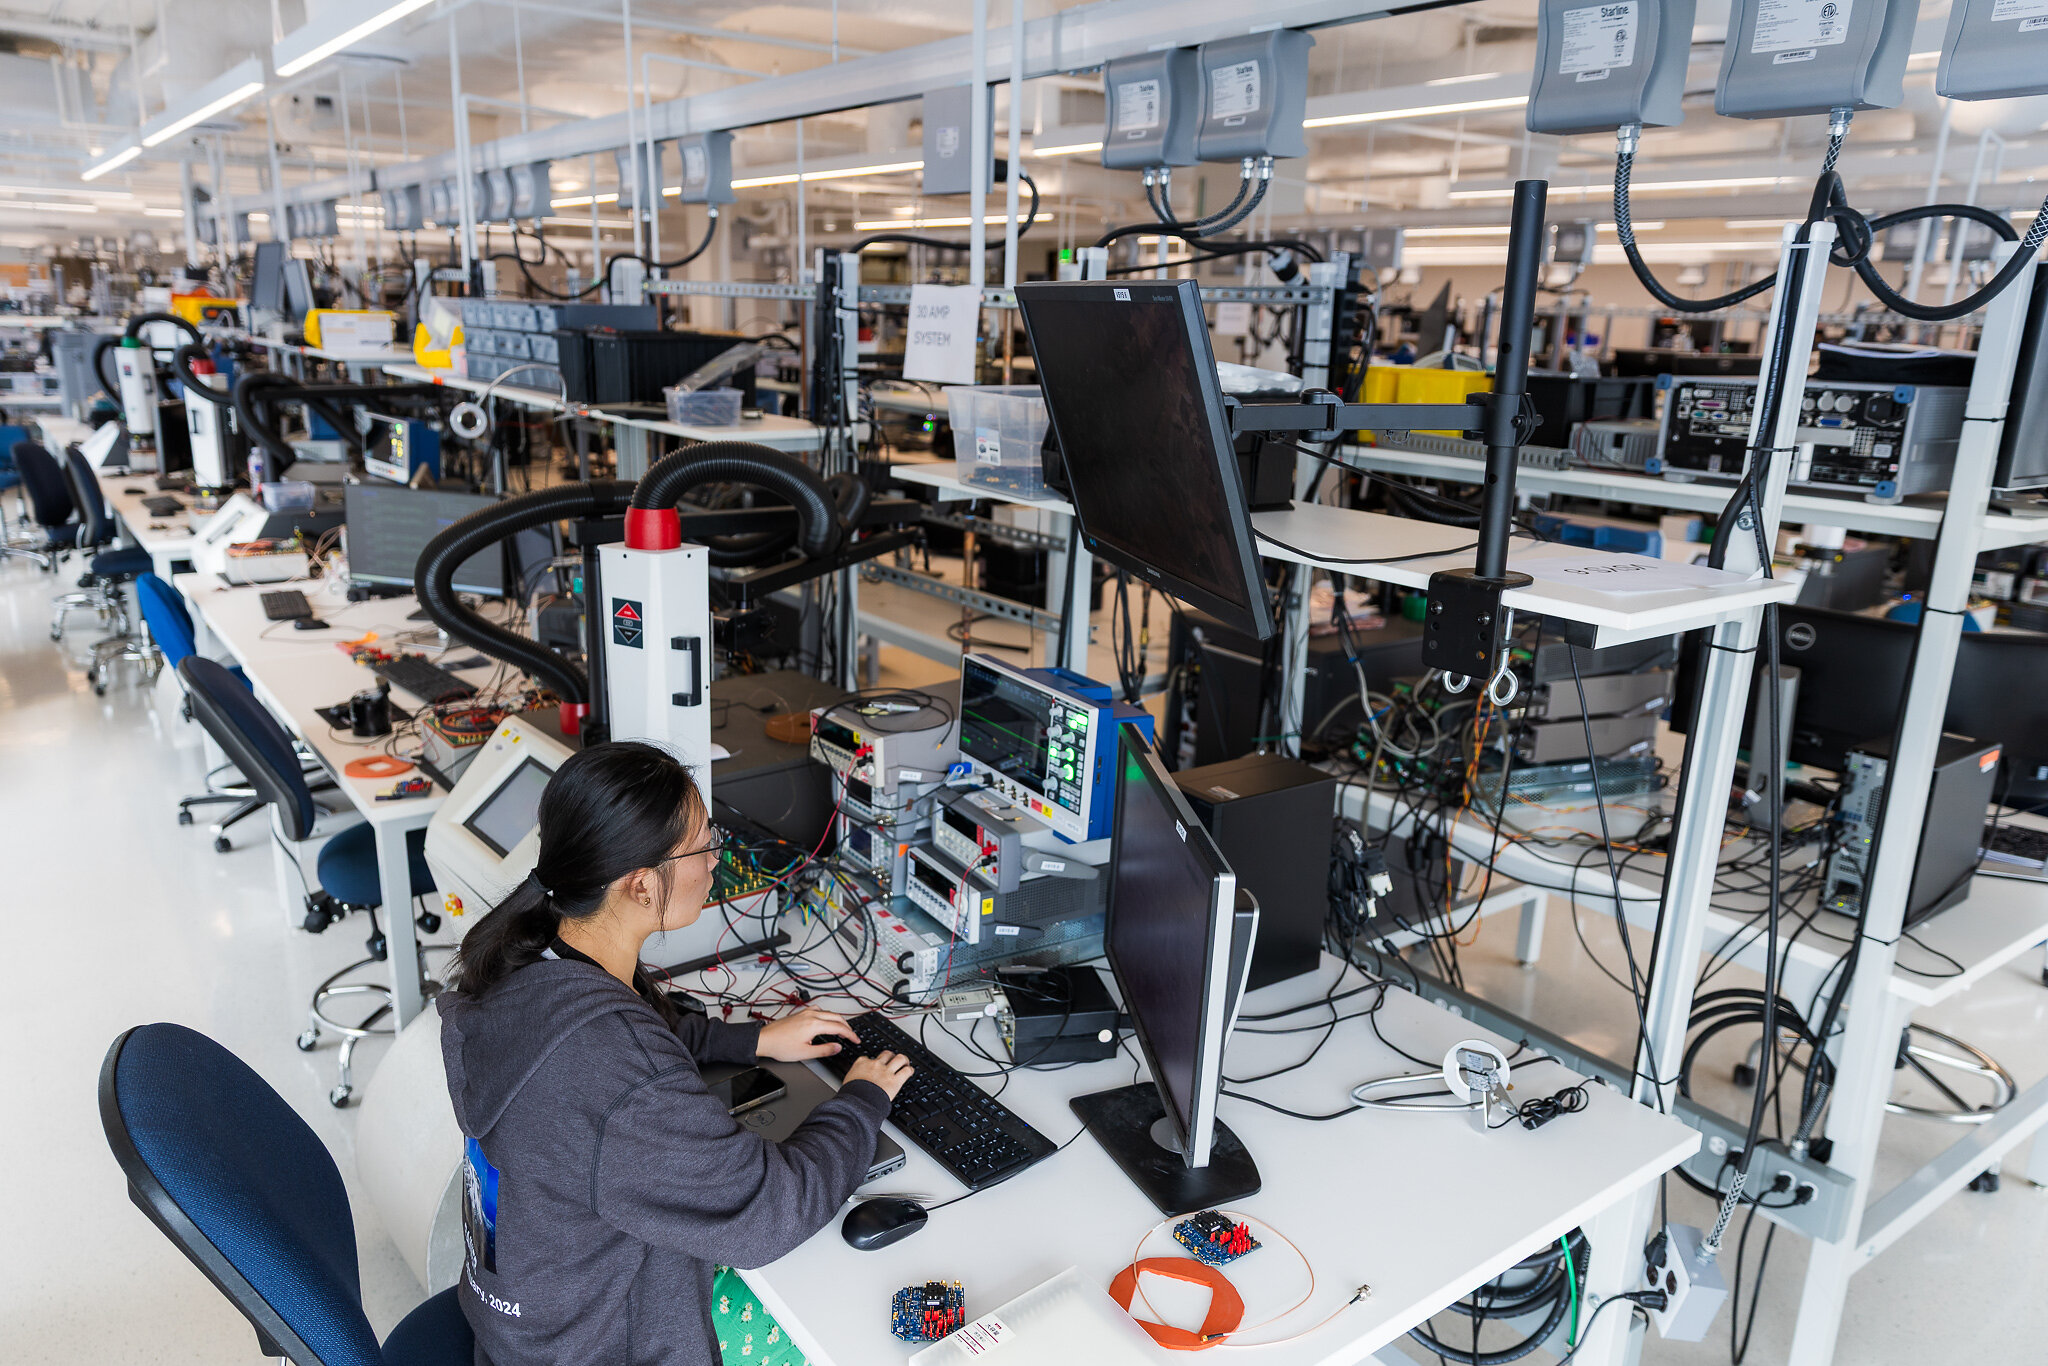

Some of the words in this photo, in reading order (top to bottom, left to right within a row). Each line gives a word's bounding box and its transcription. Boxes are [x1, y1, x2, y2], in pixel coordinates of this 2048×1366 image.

[1601, 6, 1629, 18] Starline
[929, 304, 950, 319] AMP
[914, 331, 951, 346] SYSTEM
[488, 1293, 522, 1318] 2024
